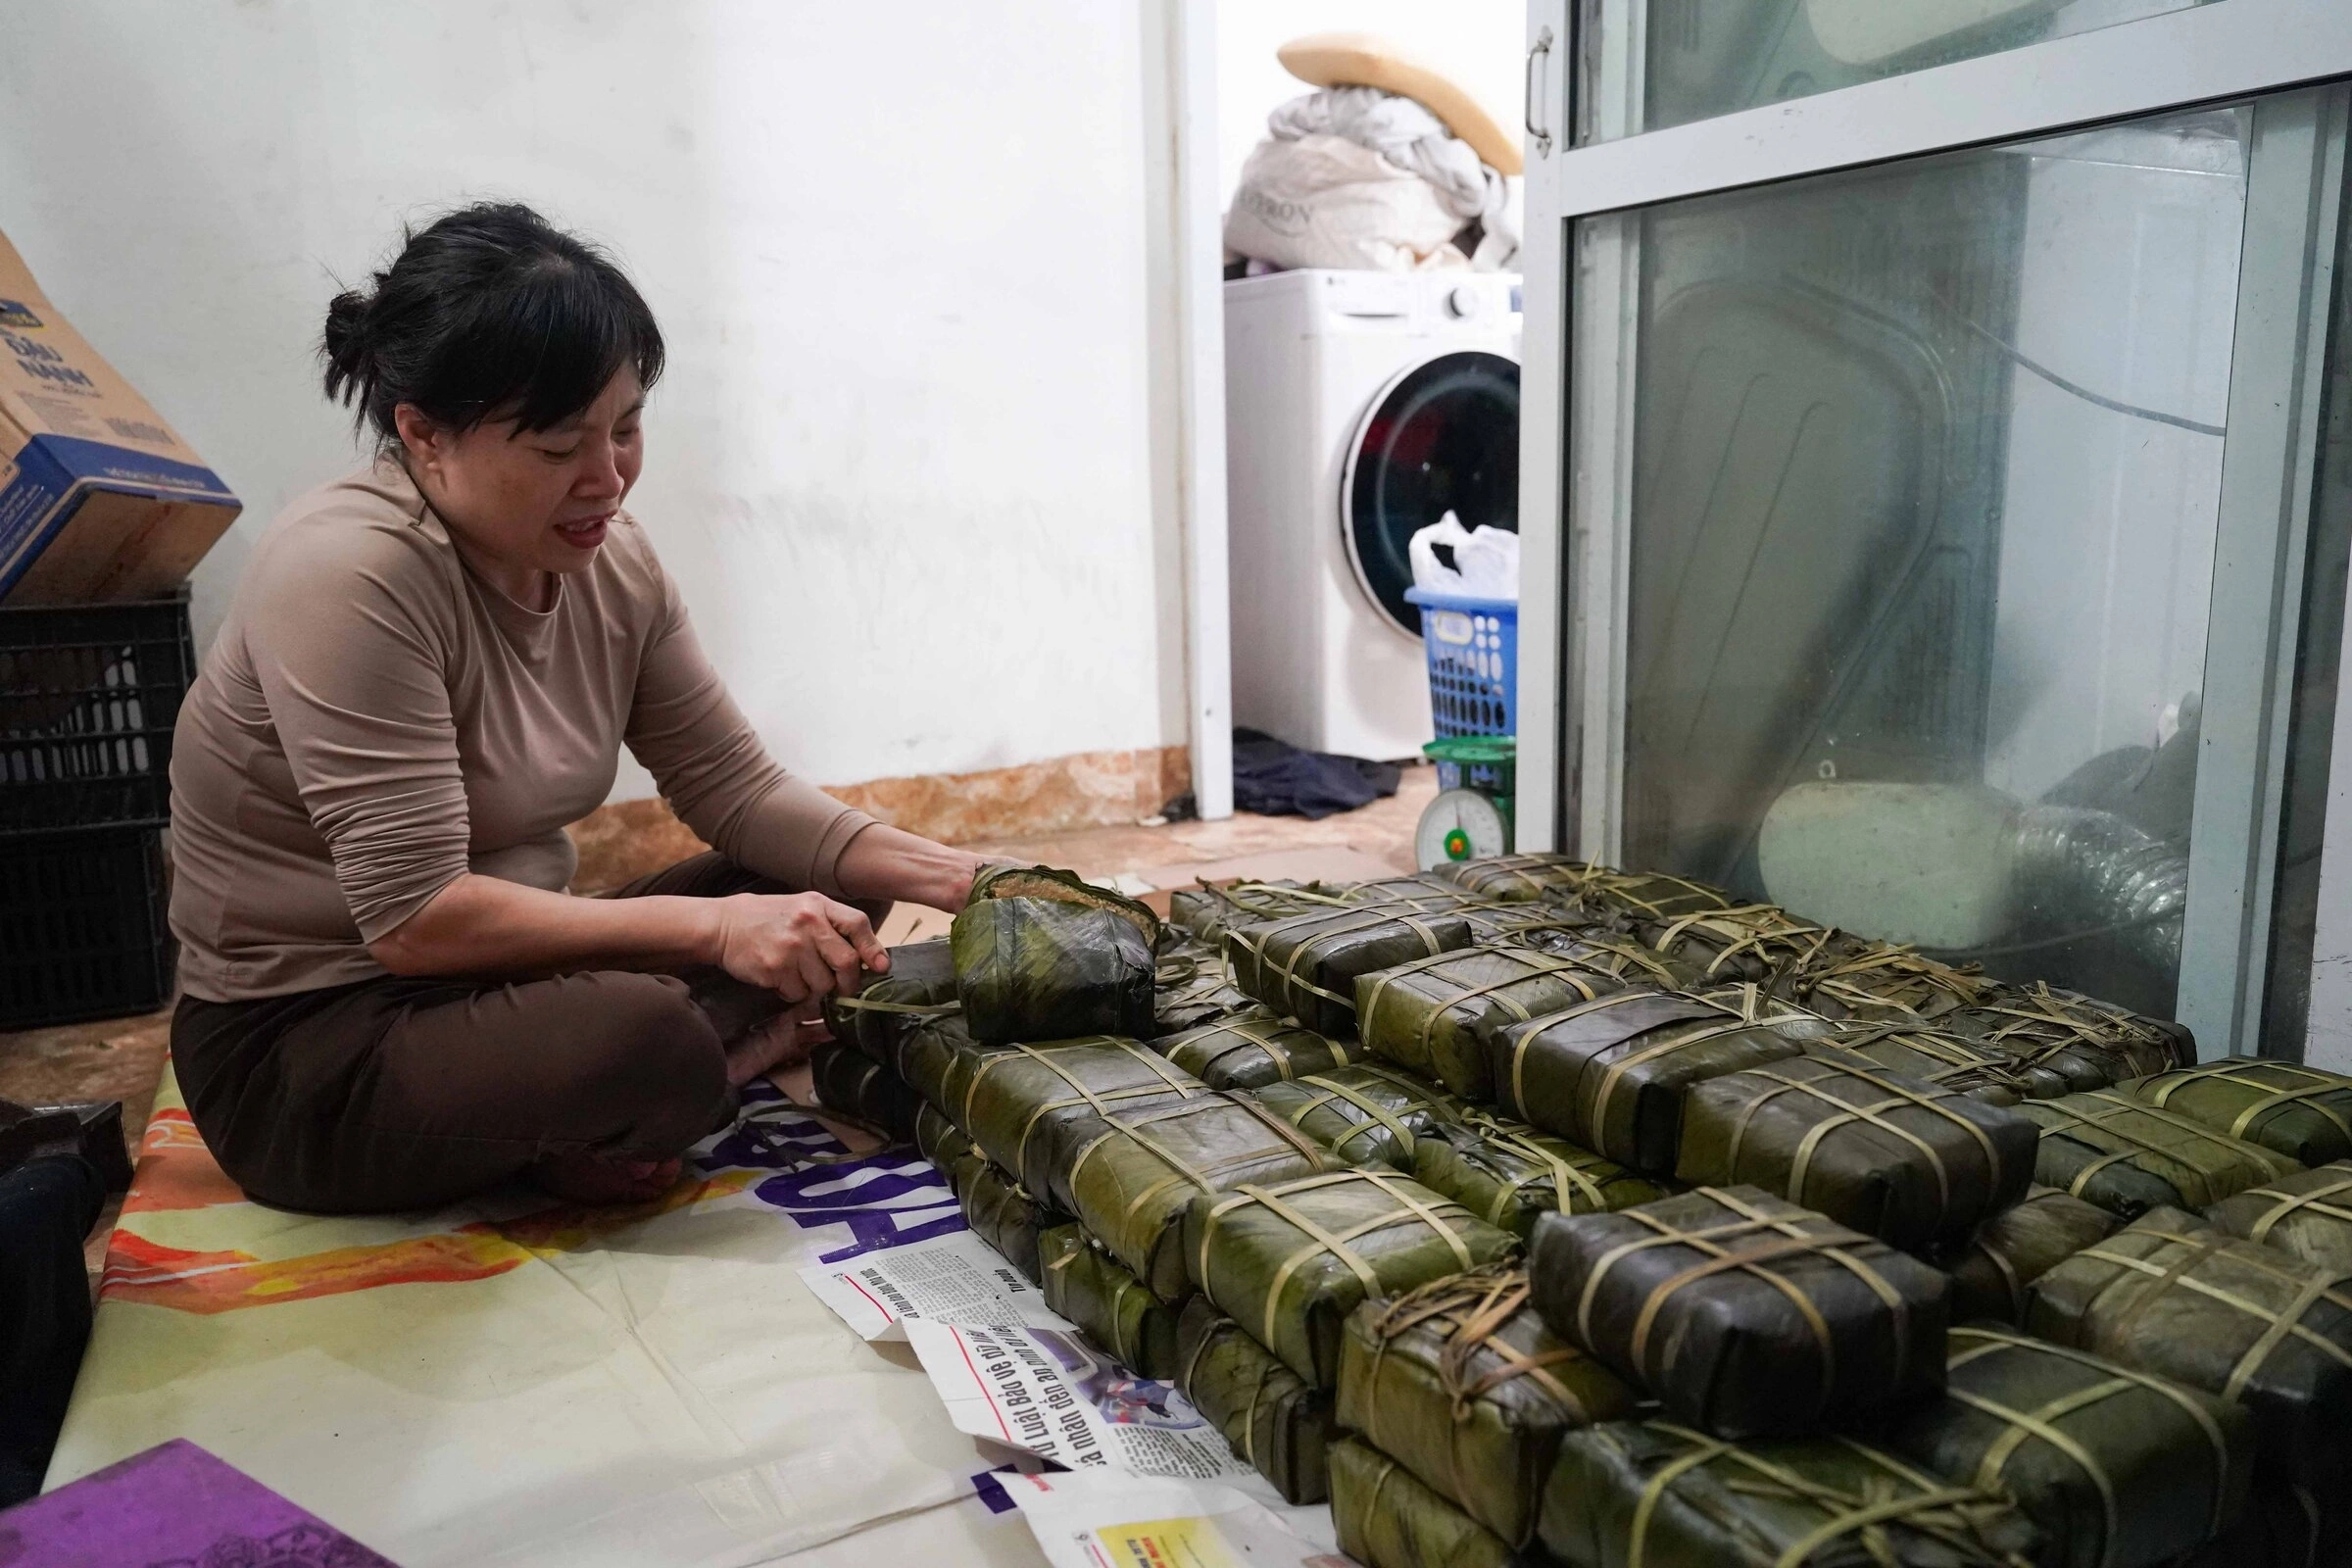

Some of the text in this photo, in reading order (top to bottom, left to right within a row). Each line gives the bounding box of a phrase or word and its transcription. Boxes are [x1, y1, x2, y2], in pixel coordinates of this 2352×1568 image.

[1007, 1283, 1027, 1293] Tin
[976, 1345, 1006, 1359] dữ
[986, 1360, 1016, 1381] vệ
[1032, 1367, 1058, 1383] an
[998, 1380, 1032, 1407] Bảo
[1039, 1383, 1075, 1410] đến
[1012, 1406, 1050, 1441] Luật
[1058, 1409, 1097, 1450] nhân
